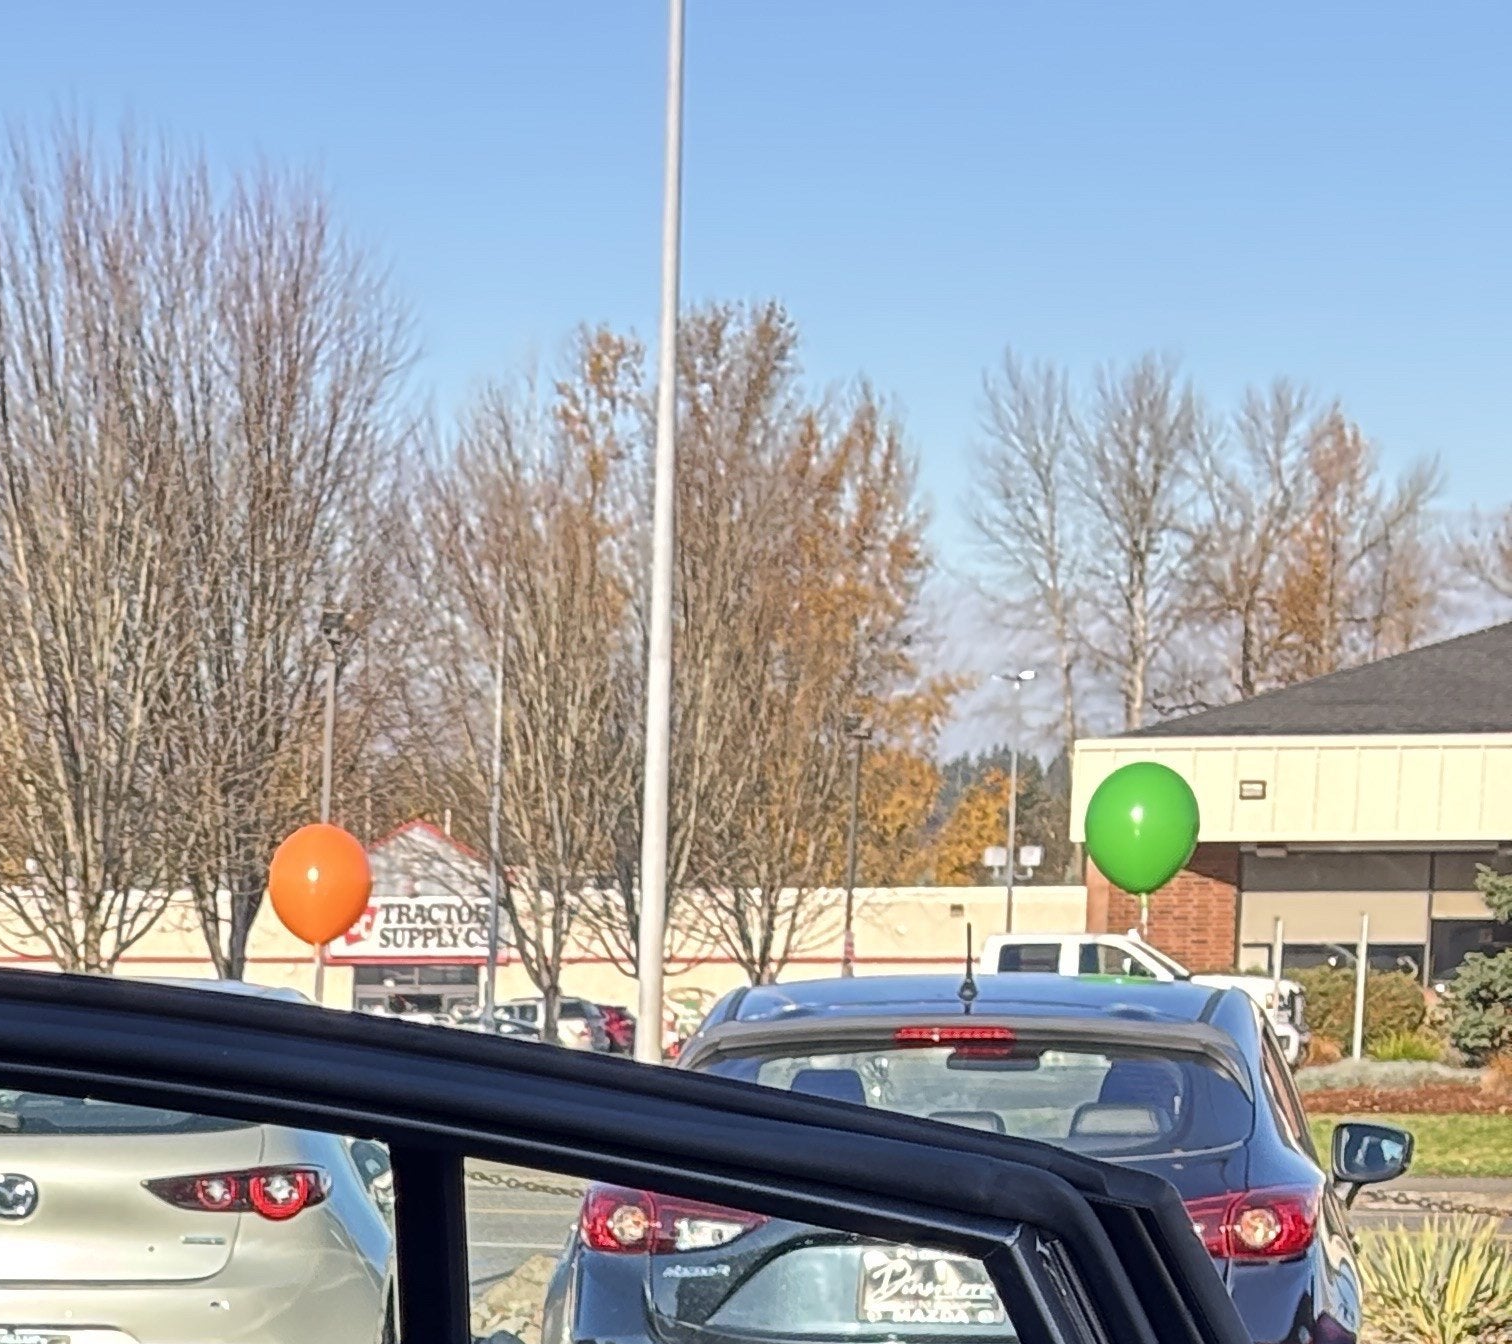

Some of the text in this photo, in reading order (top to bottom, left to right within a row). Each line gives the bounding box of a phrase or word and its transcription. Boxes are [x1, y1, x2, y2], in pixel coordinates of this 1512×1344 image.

[381, 904, 491, 925] TRACTOR
[379, 927, 460, 948] SUPPLY
[892, 1308, 970, 1324] MAZDA
